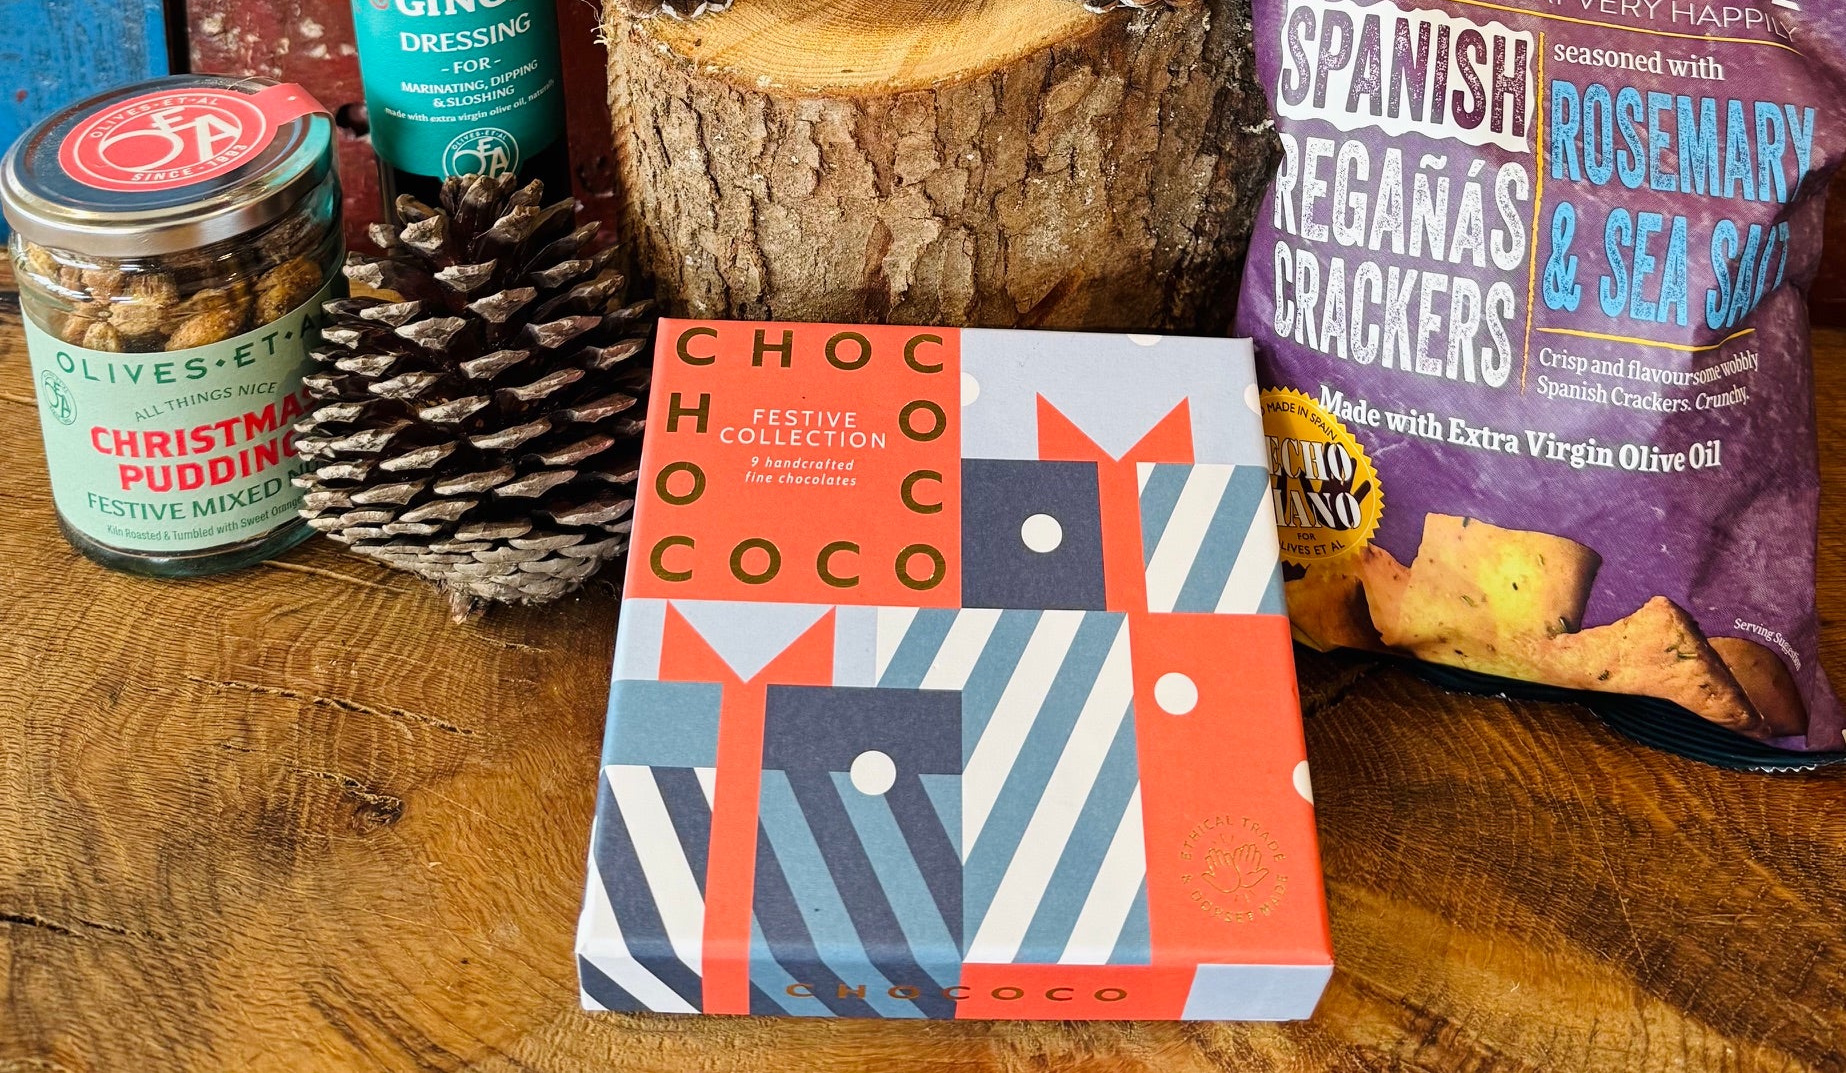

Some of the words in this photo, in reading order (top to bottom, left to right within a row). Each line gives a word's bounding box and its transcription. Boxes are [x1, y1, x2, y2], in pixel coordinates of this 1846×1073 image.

[400, 12, 532, 53] DRESSING
[1670, 2, 1797, 44] HAPPILY
[401, 80, 489, 94] MARINATING,
[490, 59, 538, 87] DIPPING
[1280, 3, 1529, 139] SPANISH
[1553, 41, 1665, 76] seasoned
[1666, 55, 1725, 82] with
[385, 106, 406, 119] made
[407, 112, 429, 122] with
[458, 110, 487, 122] virgin
[490, 104, 512, 117] olive
[513, 98, 527, 111] oil,
[1550, 79, 1816, 204] ROSEMARY
[1272, 132, 1530, 272] REGAÑÁS
[1543, 201, 1582, 313] &
[1600, 205, 1689, 328] SEA
[1272, 239, 1518, 389] CRACKERS
[1539, 347, 1588, 376] Crisp
[1590, 358, 1625, 380] and
[1627, 359, 1721, 387] flavoursome
[1721, 350, 1759, 375] wobbly
[135, 405, 165, 422] ALL
[167, 387, 233, 411] THINGS
[238, 382, 278, 397] NICE
[1536, 376, 1607, 404] Spanish
[1610, 387, 1692, 412] Crackers.
[1695, 384, 1750, 411] Crunchy.
[720, 427, 886, 448] COLLECTION
[753, 409, 857, 428] FESTIVE
[1267, 402, 1296, 413] MADE
[1298, 405, 1309, 418] IN
[1310, 413, 1337, 441] SPAIN
[1319, 384, 1381, 428] Made
[1384, 408, 1443, 441] with
[1448, 417, 1520, 455] Extra
[1524, 428, 1613, 470] Virgin
[1618, 444, 1685, 474] Olive
[1689, 439, 1722, 471] Oil
[745, 471, 773, 485] fine
[778, 472, 857, 486] chocolates
[751, 456, 759, 467] 9
[765, 457, 855, 471] handcrafted
[87, 492, 190, 520] FESTIVE
[193, 477, 283, 518] MIXED
[107, 524, 124, 536] Kiln
[125, 527, 162, 540] Roasted
[164, 531, 171, 540] &
[172, 527, 214, 541] Tumbled
[216, 521, 238, 535] with
[240, 510, 269, 527] Sweet
[1297, 532, 1316, 540] FOR
[1315, 545, 1326, 555] ET
[1332, 540, 1345, 552] AL
[1734, 618, 1775, 641] Serving
[785, 983, 1128, 1002] CHOCOCO
